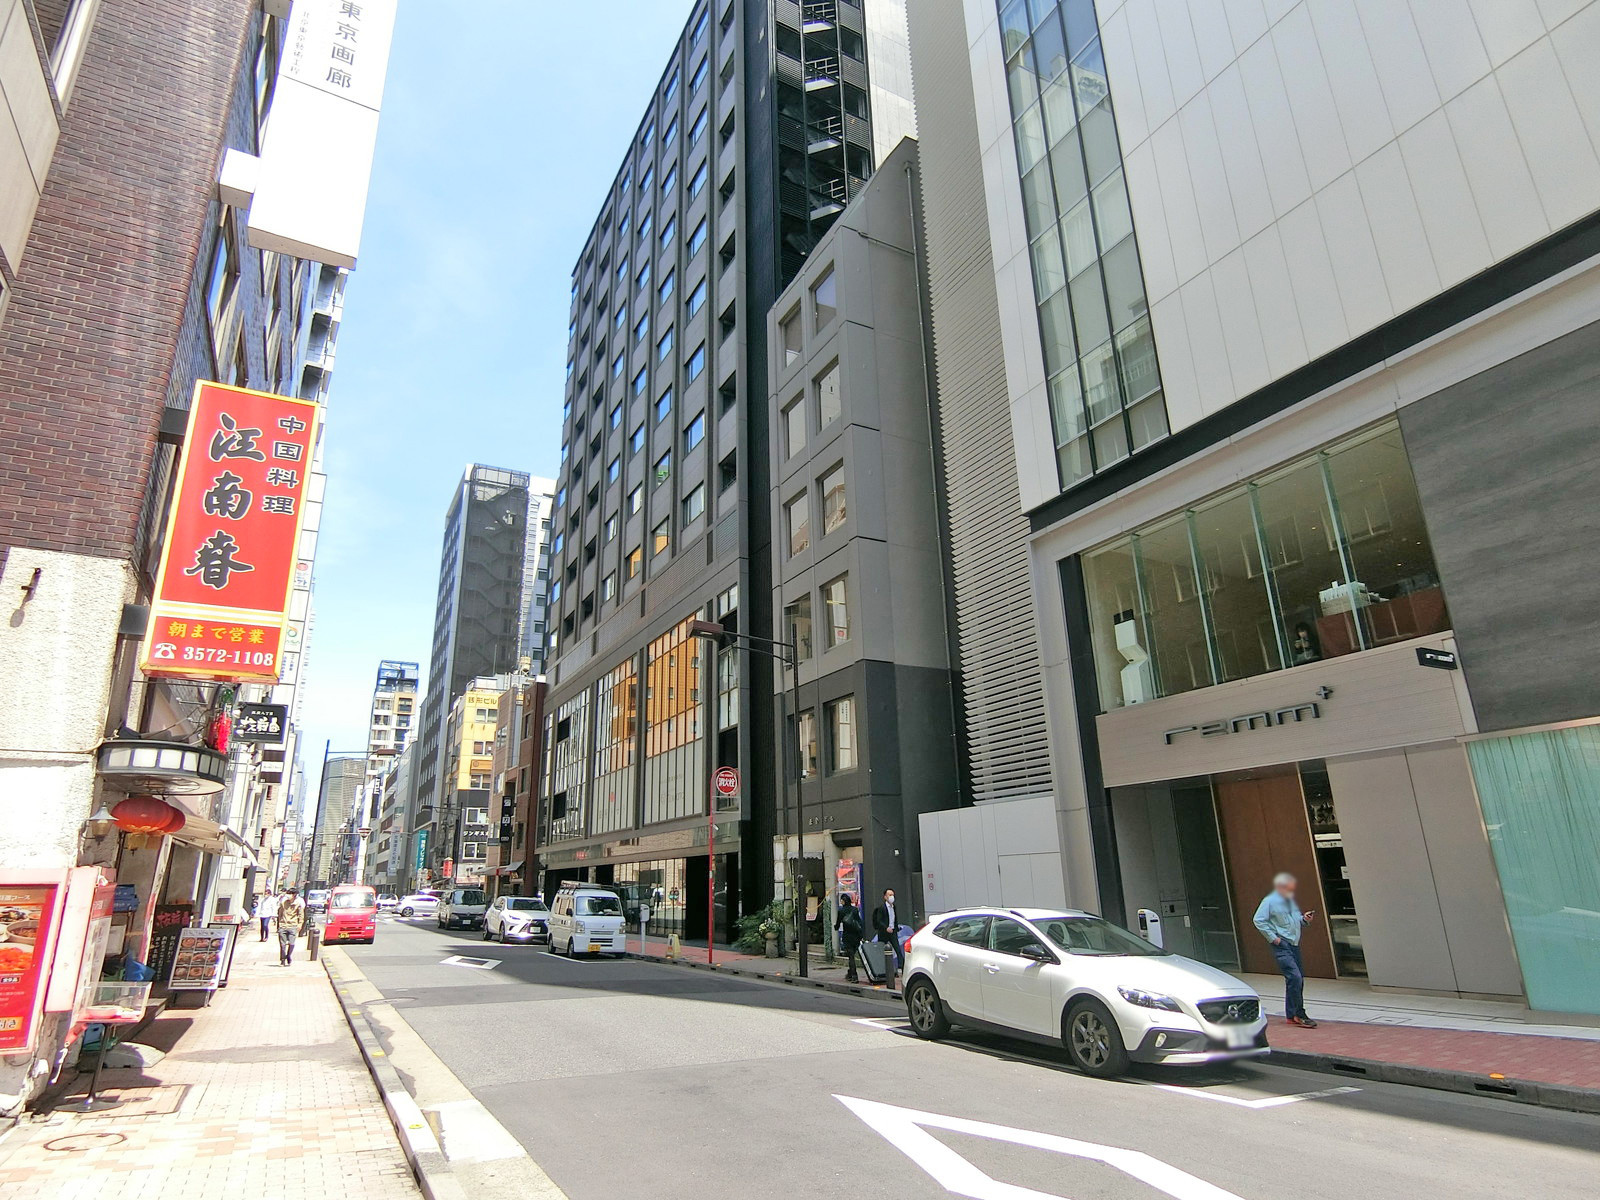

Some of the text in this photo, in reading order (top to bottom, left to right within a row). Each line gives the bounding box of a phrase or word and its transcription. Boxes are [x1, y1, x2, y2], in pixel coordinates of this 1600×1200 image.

[326, 0, 363, 88] 東京画廊
[262, 416, 306, 515] 中国料理
[184, 412, 266, 590] 江南春
[168, 621, 265, 644] 朝まで営業
[183, 646, 274, 667] 3572-1108
[718, 777, 736, 788] 消火栓
